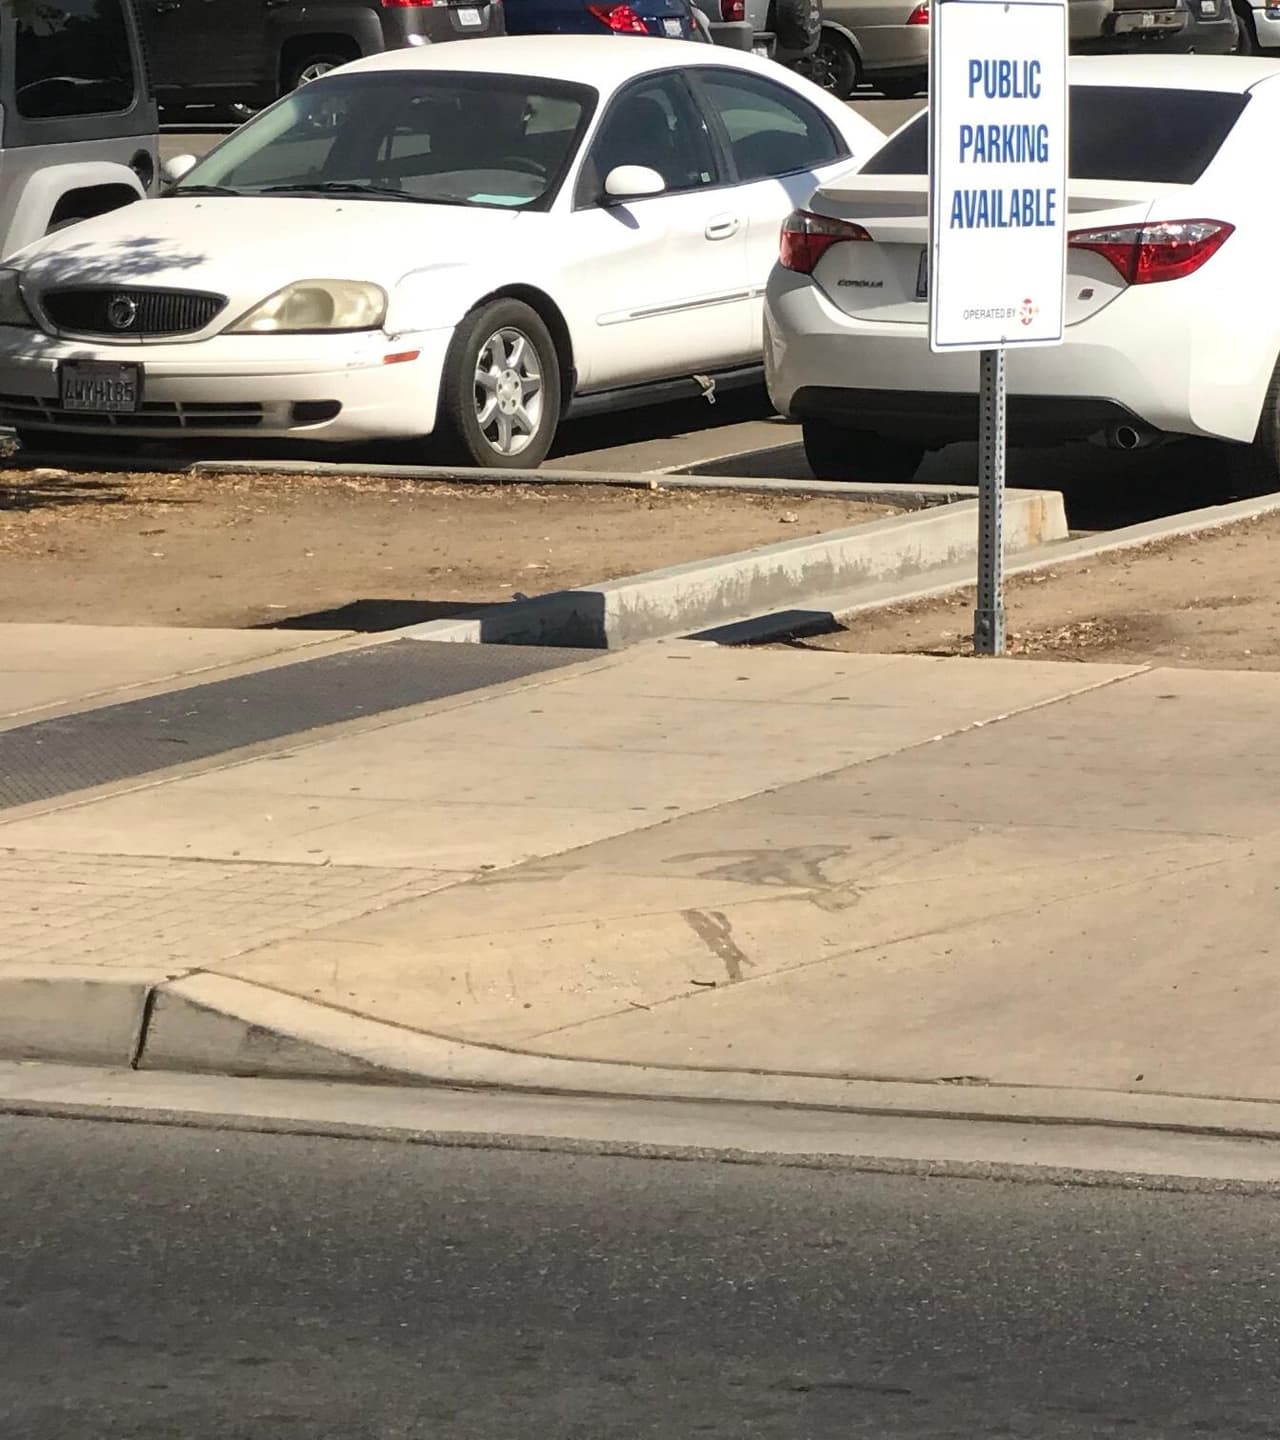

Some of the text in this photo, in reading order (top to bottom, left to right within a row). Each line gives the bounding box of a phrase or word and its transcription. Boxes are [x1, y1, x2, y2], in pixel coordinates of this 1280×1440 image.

[968, 59, 1042, 99] PUBLIC
[958, 124, 1050, 164] PARKING
[949, 188, 1057, 229] AVAILABLE
[962, 308, 1005, 321] OPERATED
[1006, 307, 1016, 319] BY
